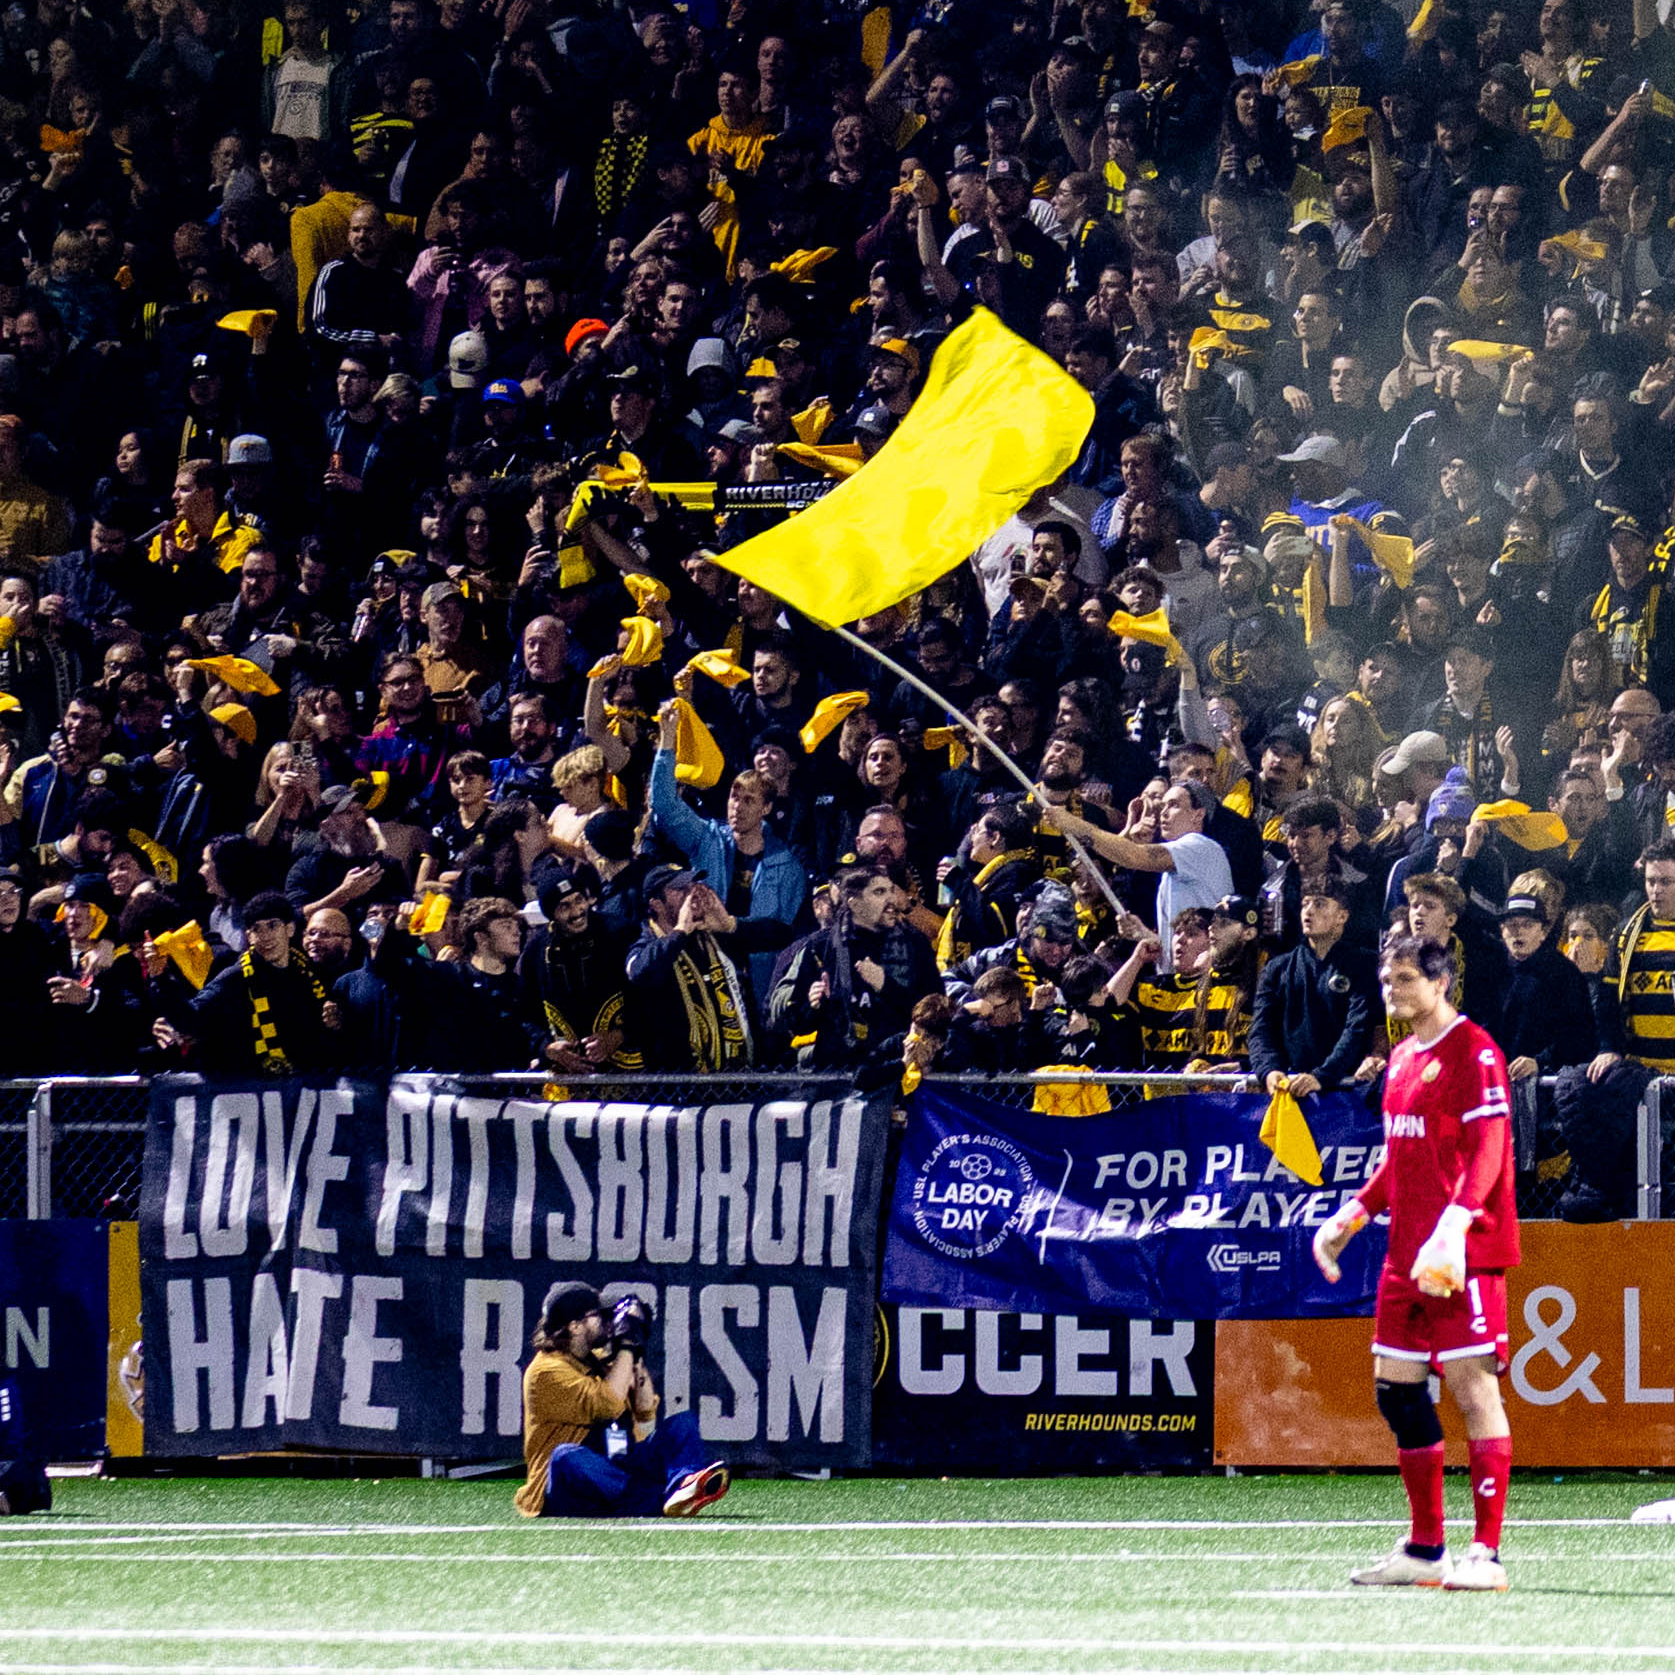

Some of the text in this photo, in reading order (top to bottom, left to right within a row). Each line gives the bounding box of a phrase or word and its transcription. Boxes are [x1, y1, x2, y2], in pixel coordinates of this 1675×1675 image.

[165, 1089, 868, 1266] LOVE PITTSBURGH
[913, 1175, 925, 1200] USL
[973, 1134, 1034, 1183] ASSOCIATION
[1094, 1151, 1188, 1189] FOR
[927, 1182, 1015, 1208] LABOR
[913, 1210, 974, 1259] ASSOCIATION
[941, 1208, 989, 1232] DAY
[1100, 1196, 1170, 1238] BY
[1220, 1249, 1282, 1266] USLPA
[1467, 1276, 1484, 1317] 1
[165, 1268, 848, 1443] HATE RISM
[1024, 1411, 1197, 1434] RIVERHOUNDS.COM
